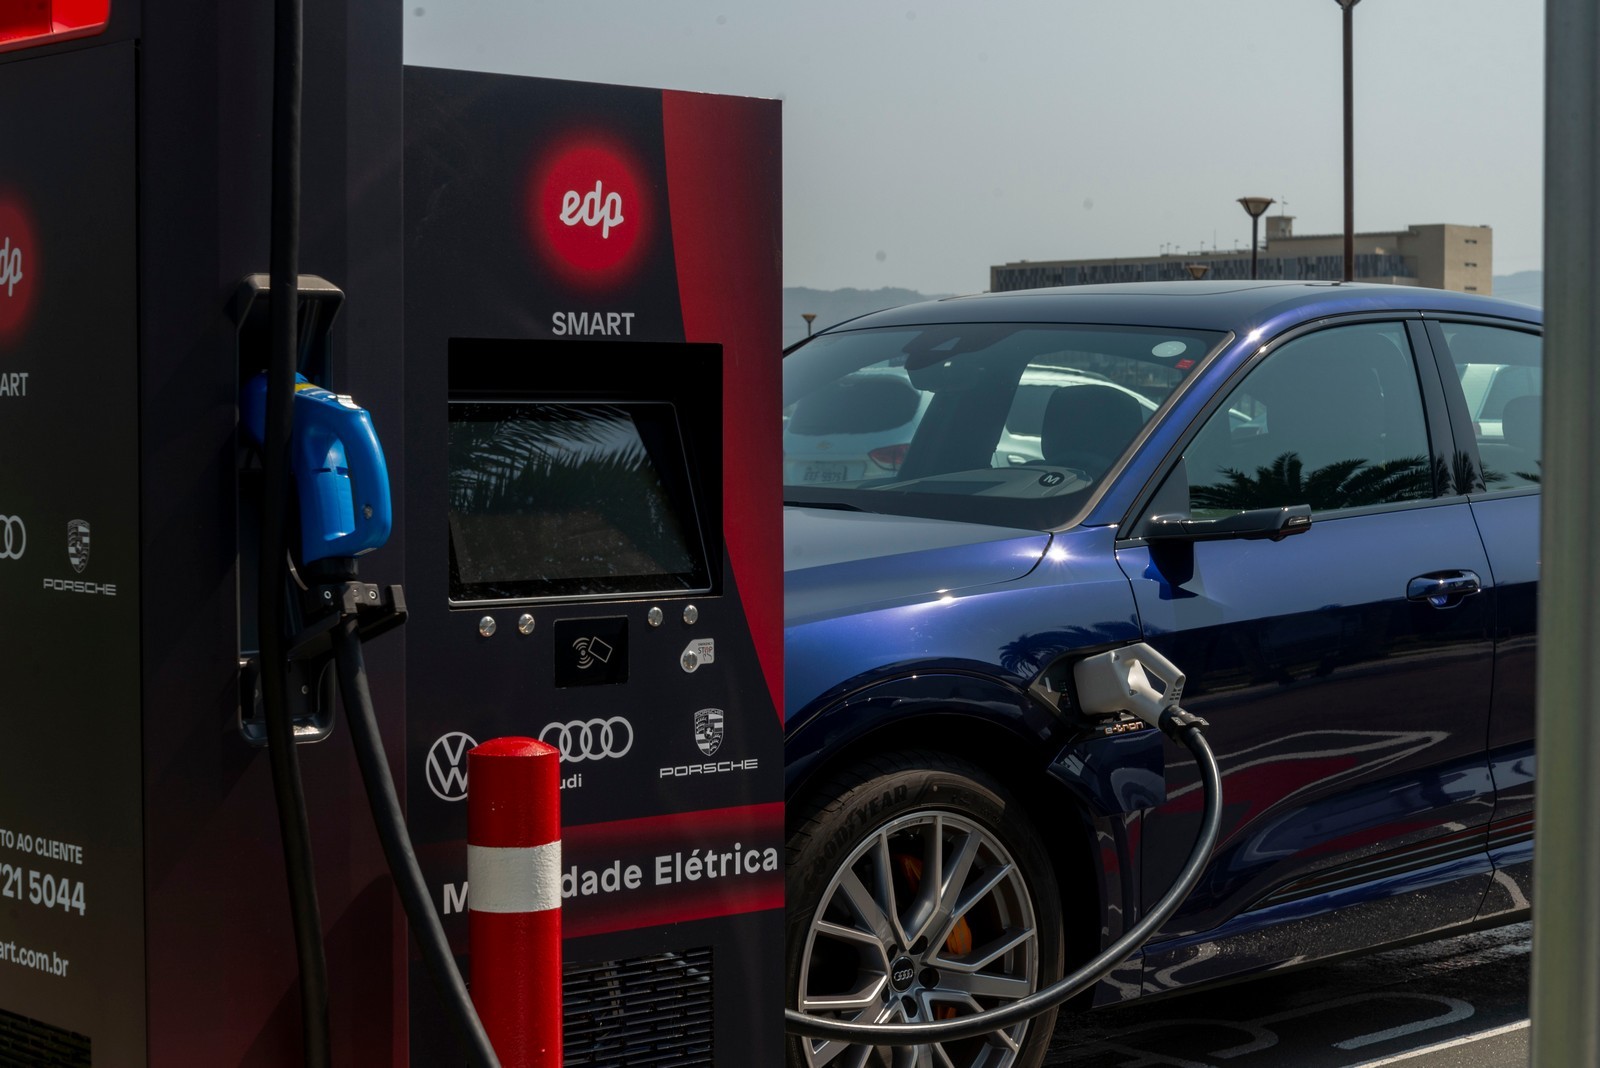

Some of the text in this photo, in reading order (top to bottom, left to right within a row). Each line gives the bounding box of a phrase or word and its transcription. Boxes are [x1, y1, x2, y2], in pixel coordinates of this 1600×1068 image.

[559, 180, 624, 239] edp
[552, 311, 635, 336] SMART
[0, 372, 29, 397] ART
[43, 578, 117, 596] PORSCHE
[1105, 721, 1144, 734] e-tron
[559, 773, 582, 789] udi
[660, 759, 759, 778] PORSCHE
[16, 833, 33, 853] AO
[35, 837, 84, 865] CLIENTE
[655, 842, 779, 886] Elétrica
[29, 869, 87, 917] 5044
[0, 941, 69, 978] art.com.br
